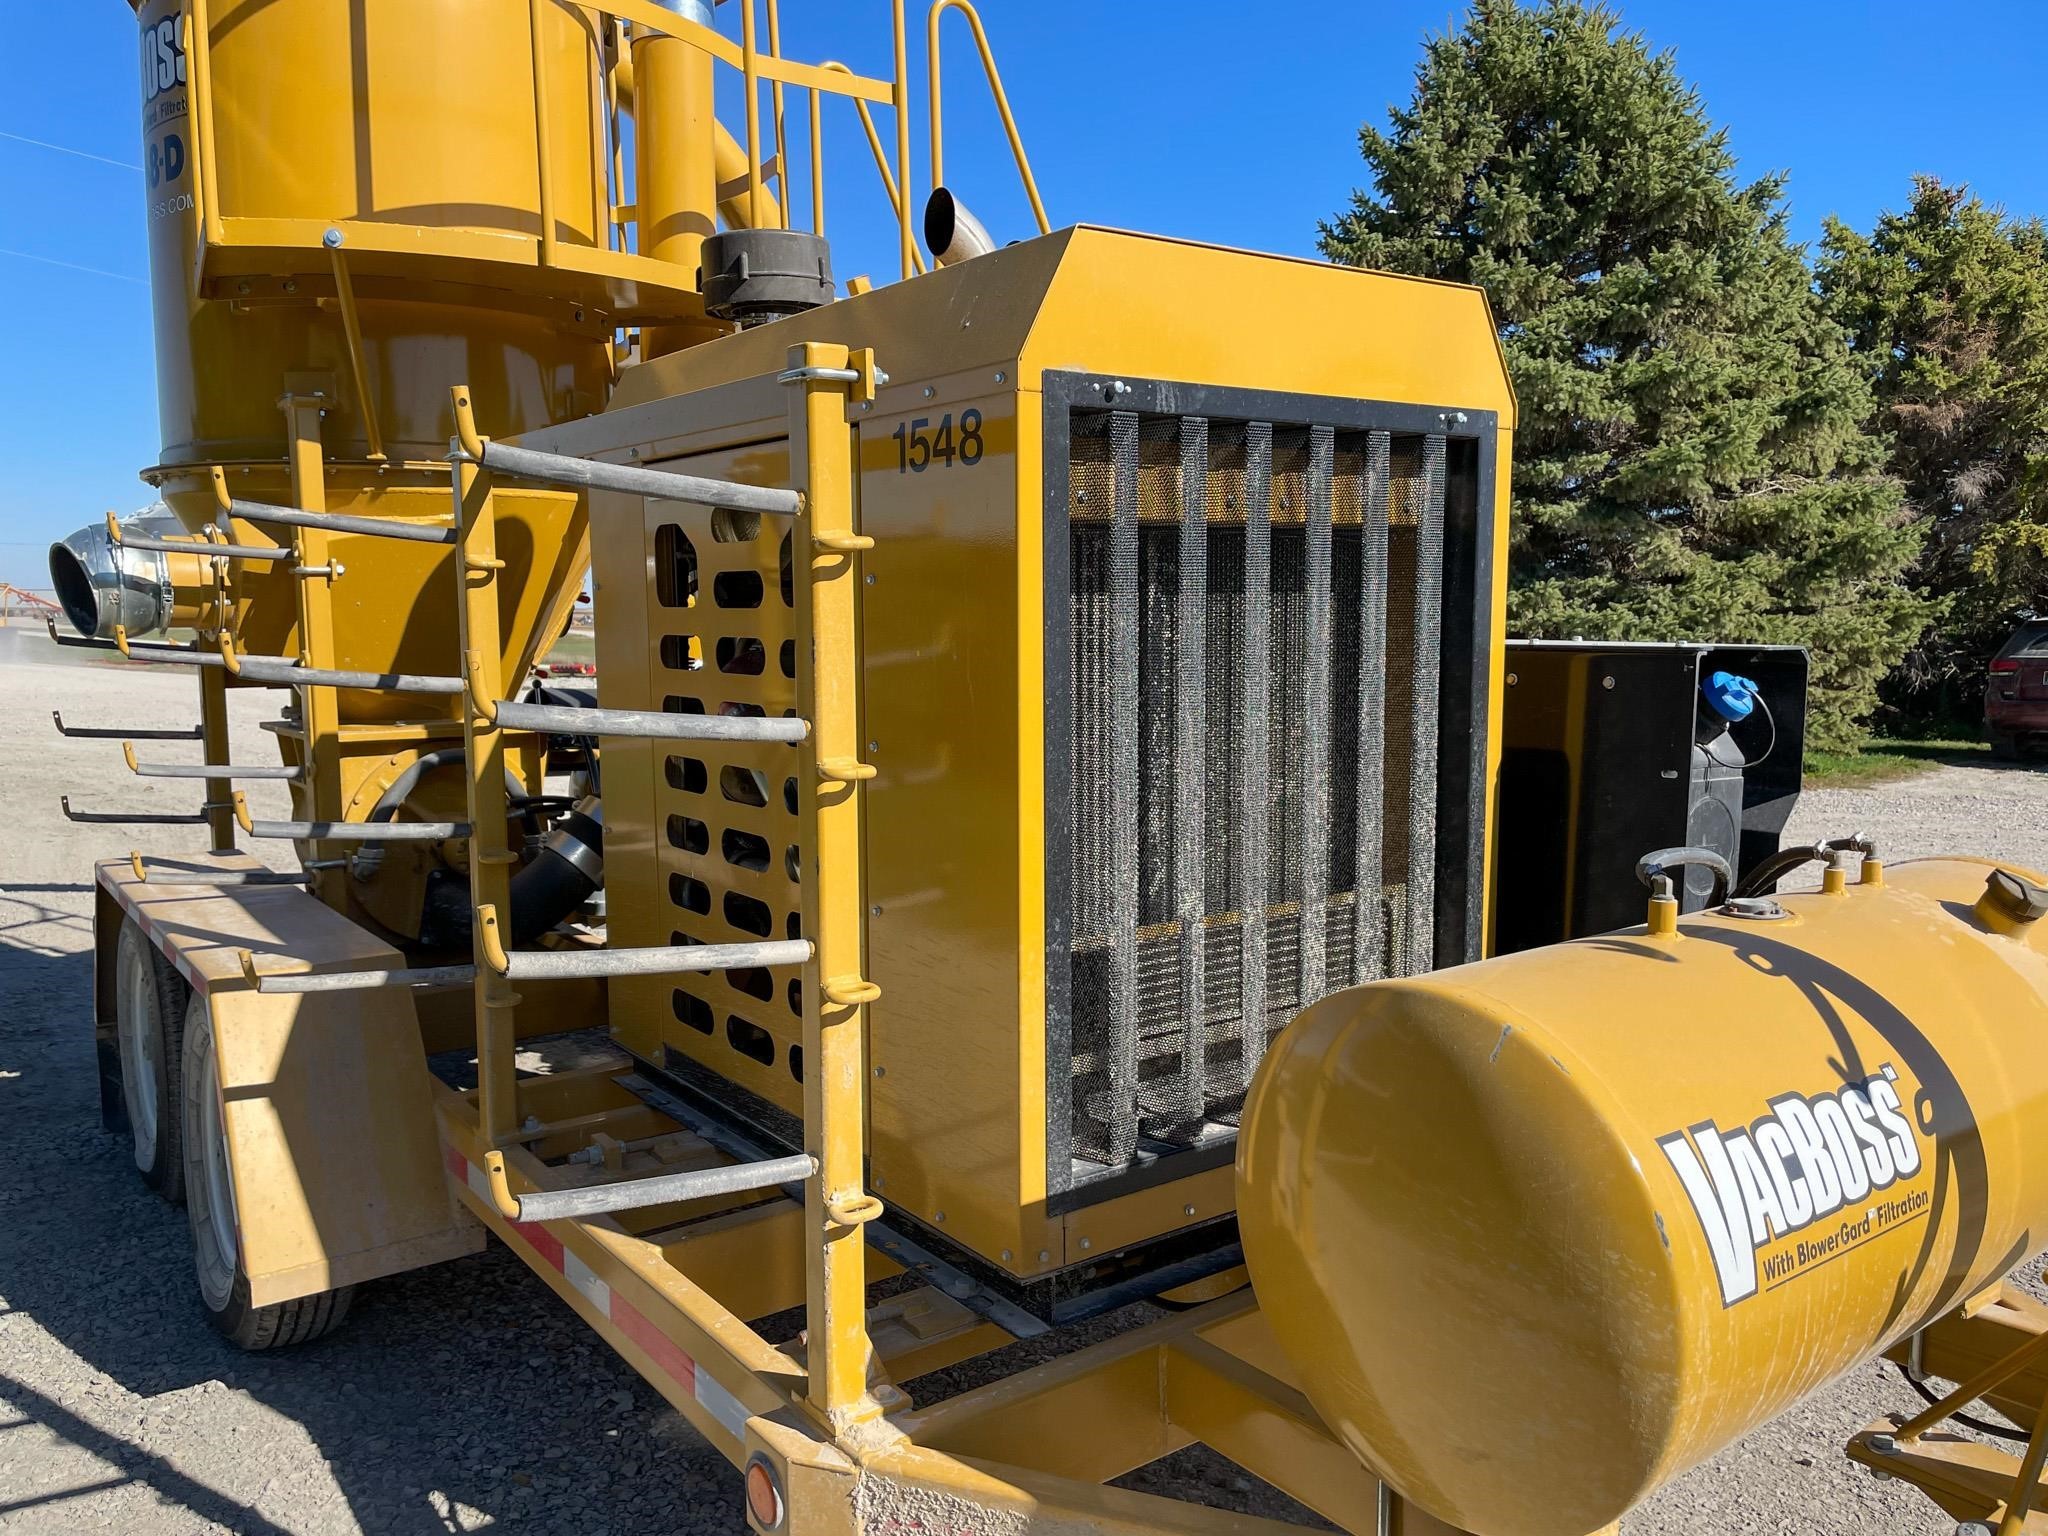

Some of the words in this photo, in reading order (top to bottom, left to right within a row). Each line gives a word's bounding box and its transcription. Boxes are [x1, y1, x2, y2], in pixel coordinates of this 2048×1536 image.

[140, 13, 187, 104] OSS
[892, 408, 984, 474] 1548
[1763, 1253, 1795, 1282] With
[1796, 1212, 1871, 1267] BlowerGard
[1876, 1190, 1929, 1228] Filtration
